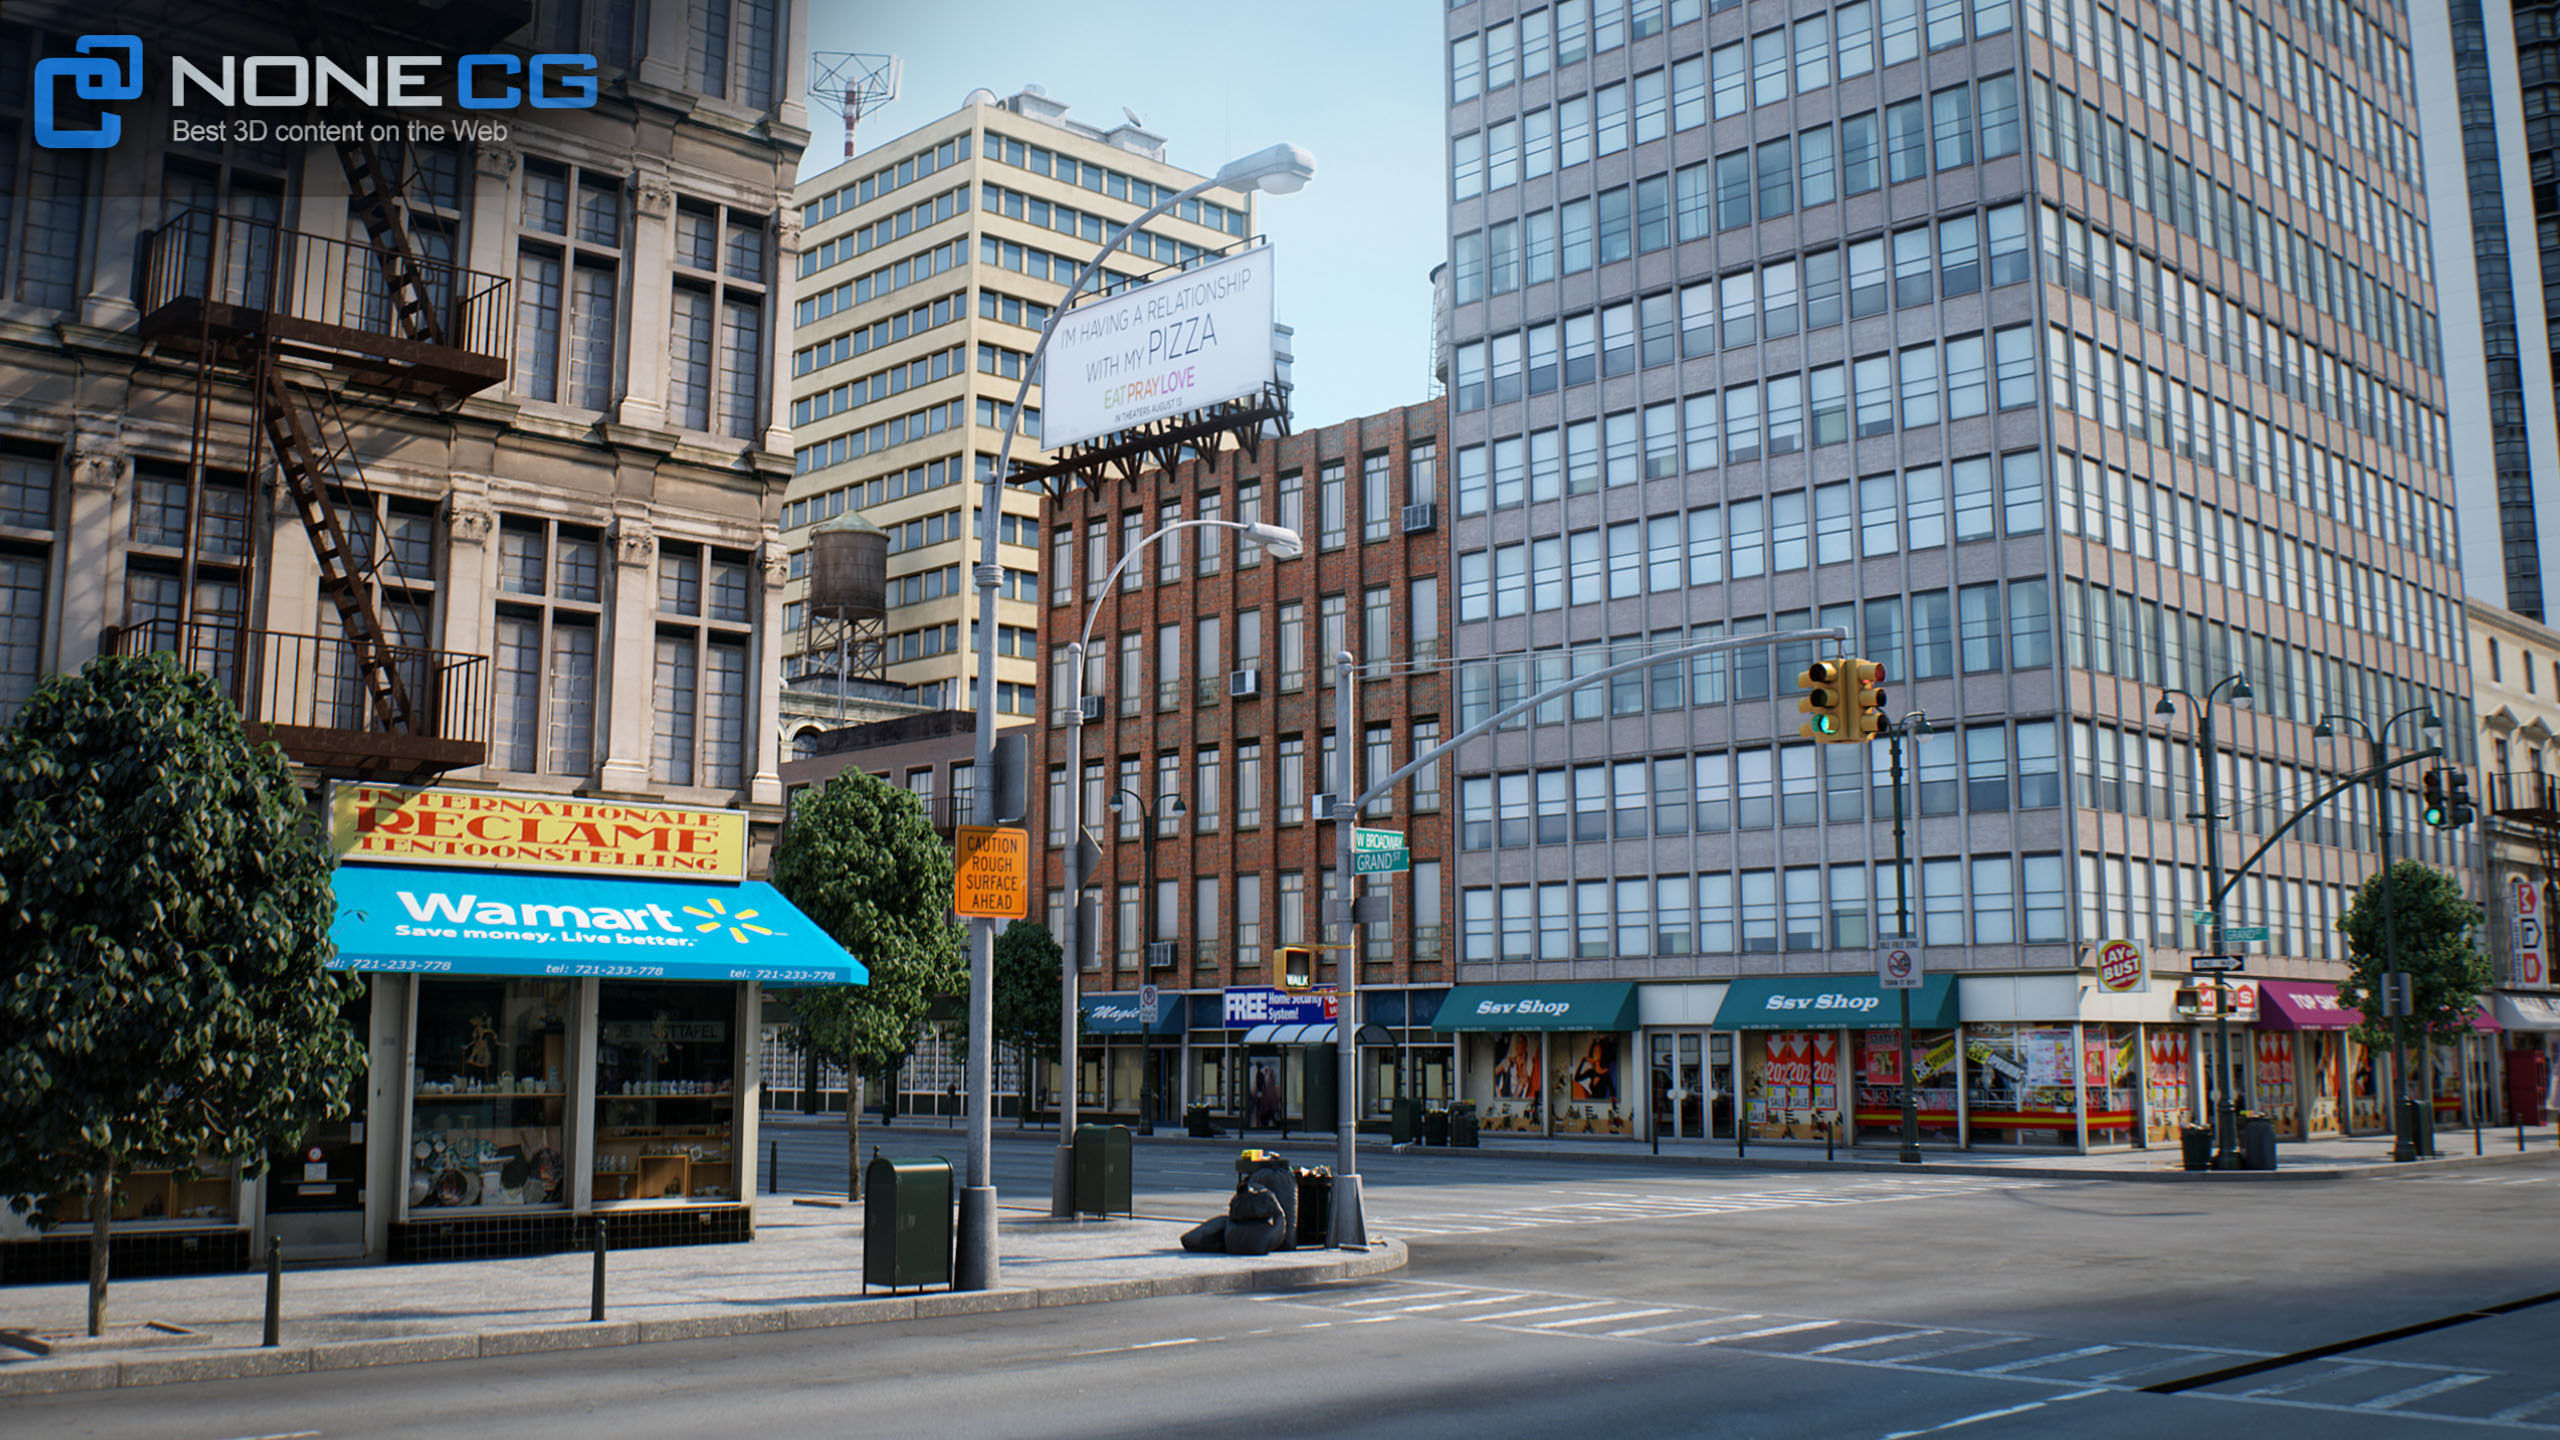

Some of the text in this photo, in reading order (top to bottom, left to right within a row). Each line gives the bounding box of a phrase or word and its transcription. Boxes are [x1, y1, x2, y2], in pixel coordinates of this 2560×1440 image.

[1060, 267, 1252, 350] I'M HAVING A RELATIONSHIP
[1086, 312, 1218, 383] WITH MY PIZZA
[1114, 413, 1121, 423] IN
[1122, 404, 1151, 420] THEATERS
[1151, 397, 1176, 414] AUGUST
[356, 788, 720, 829] INTERNATIONALE
[353, 805, 720, 856] RECLAME
[1356, 831, 1365, 848] W
[354, 835, 719, 871] TENTOONSTELLING
[966, 835, 1018, 854] CAUTION
[972, 855, 1013, 873] ROUGH
[1357, 852, 1393, 871] GRAND
[966, 873, 1018, 892] SURFACE
[972, 892, 1013, 910] AHEAD
[395, 890, 684, 933] Wamart
[395, 924, 696, 947] Save money. Live better.
[2225, 930, 2256, 940] GRAND
[321, 957, 453, 972] el: 721-233-778
[2101, 946, 2126, 966] LAY
[545, 963, 665, 977] tel: 721-233-778
[729, 969, 837, 980] tel: 721-233-778
[2103, 958, 2140, 981] BUST
[1286, 973, 1309, 987] WALK
[1225, 991, 1268, 1021] FREE
[1267, 991, 1291, 1006] Home
[1291, 993, 1323, 1008] Security
[1475, 999, 1571, 1017] Ssv Shop
[1764, 993, 1881, 1013] Ssv Shop
[1267, 1006, 1300, 1024] System!
[1789, 1061, 1811, 1084] 20%
[1814, 1060, 1837, 1083] 20%
